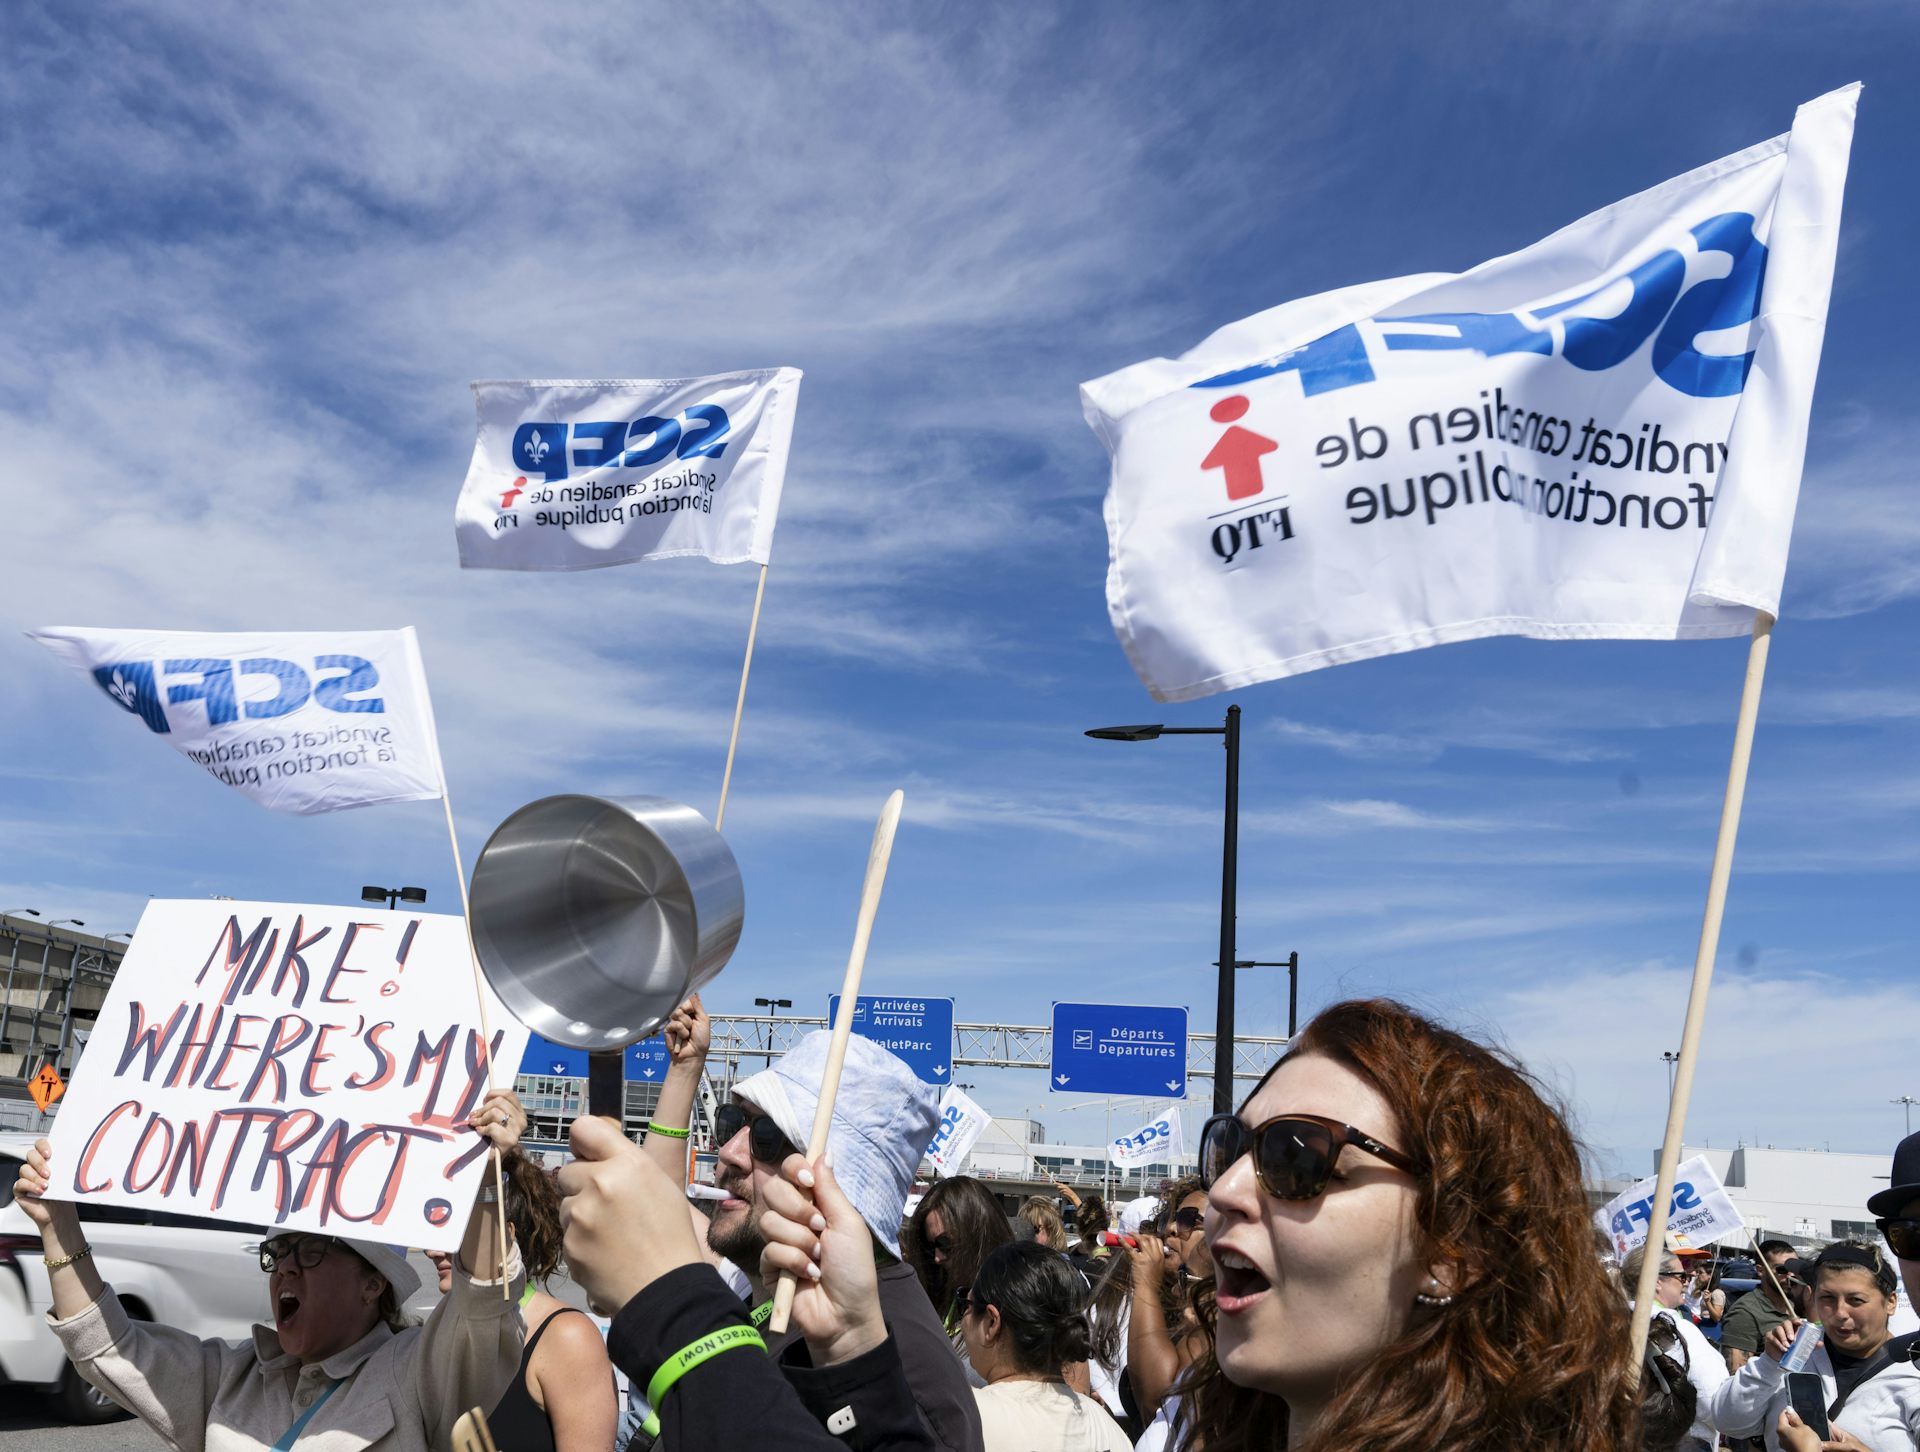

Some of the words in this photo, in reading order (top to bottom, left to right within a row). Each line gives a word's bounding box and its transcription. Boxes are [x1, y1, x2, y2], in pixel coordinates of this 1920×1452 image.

[194, 913, 422, 1008] MIKE!
[873, 1000, 926, 1012] Arrivées
[873, 1015, 923, 1027] Arrivals
[1111, 1027, 1165, 1041] Départs
[1098, 1043, 1176, 1058] Departures
[113, 1001, 397, 1104] WHERE'S
[404, 1023, 505, 1125] MY
[73, 1100, 492, 1228] CONTRACT?
[678, 1339, 717, 1368] Now!
